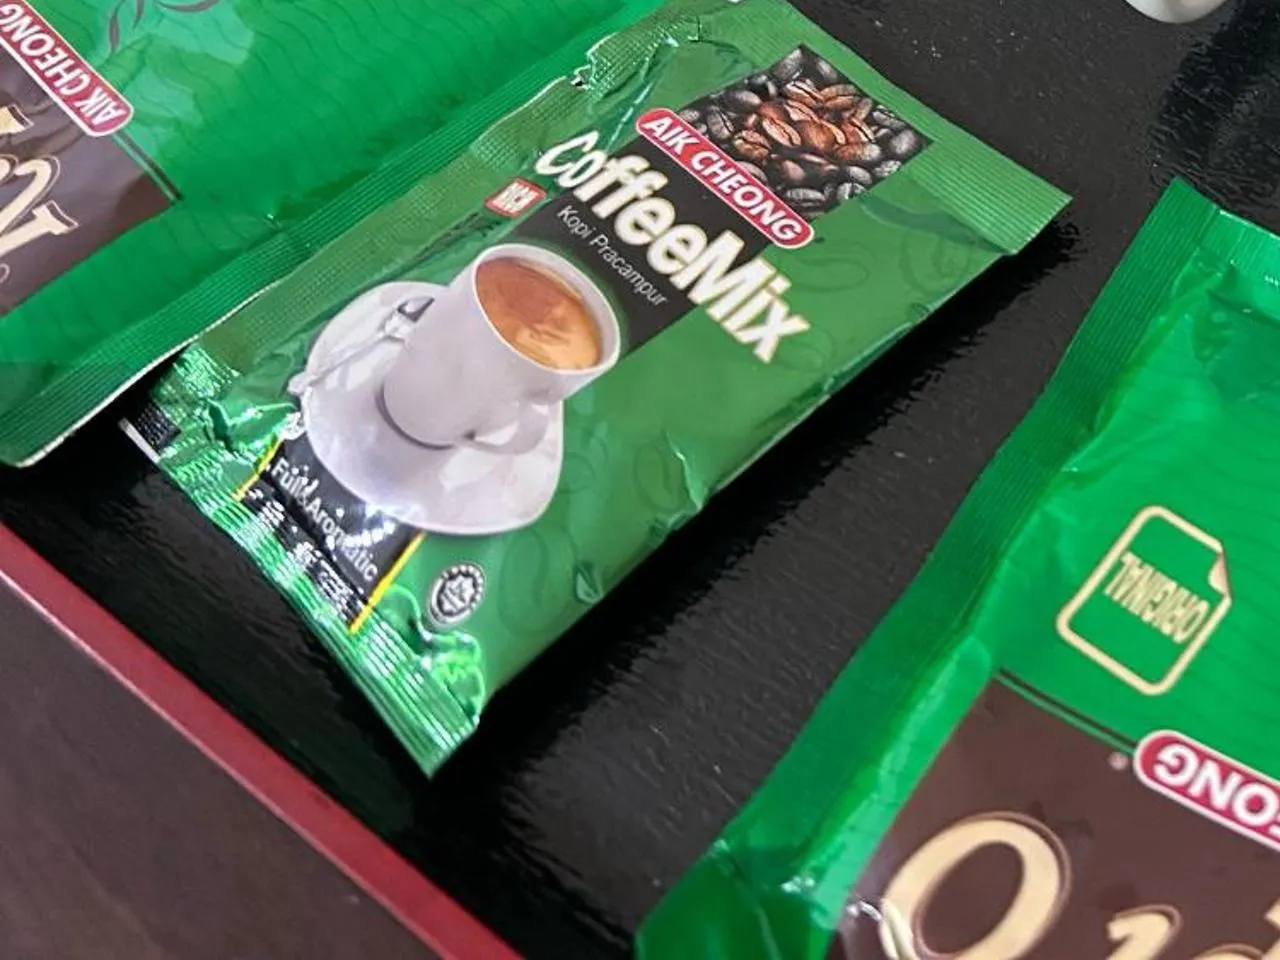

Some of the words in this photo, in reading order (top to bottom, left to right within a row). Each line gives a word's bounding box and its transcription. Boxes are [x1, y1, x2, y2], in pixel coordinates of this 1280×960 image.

[0, 3, 88, 95] CHEONG
[75, 86, 127, 125] AIK
[643, 116, 700, 154] AIK
[691, 151, 802, 240] CHEONG
[534, 130, 811, 364] CoffeeMix
[557, 205, 597, 239] Kopi
[589, 234, 669, 307] Pracampur
[1104, 551, 1209, 644] ORIGINAL
